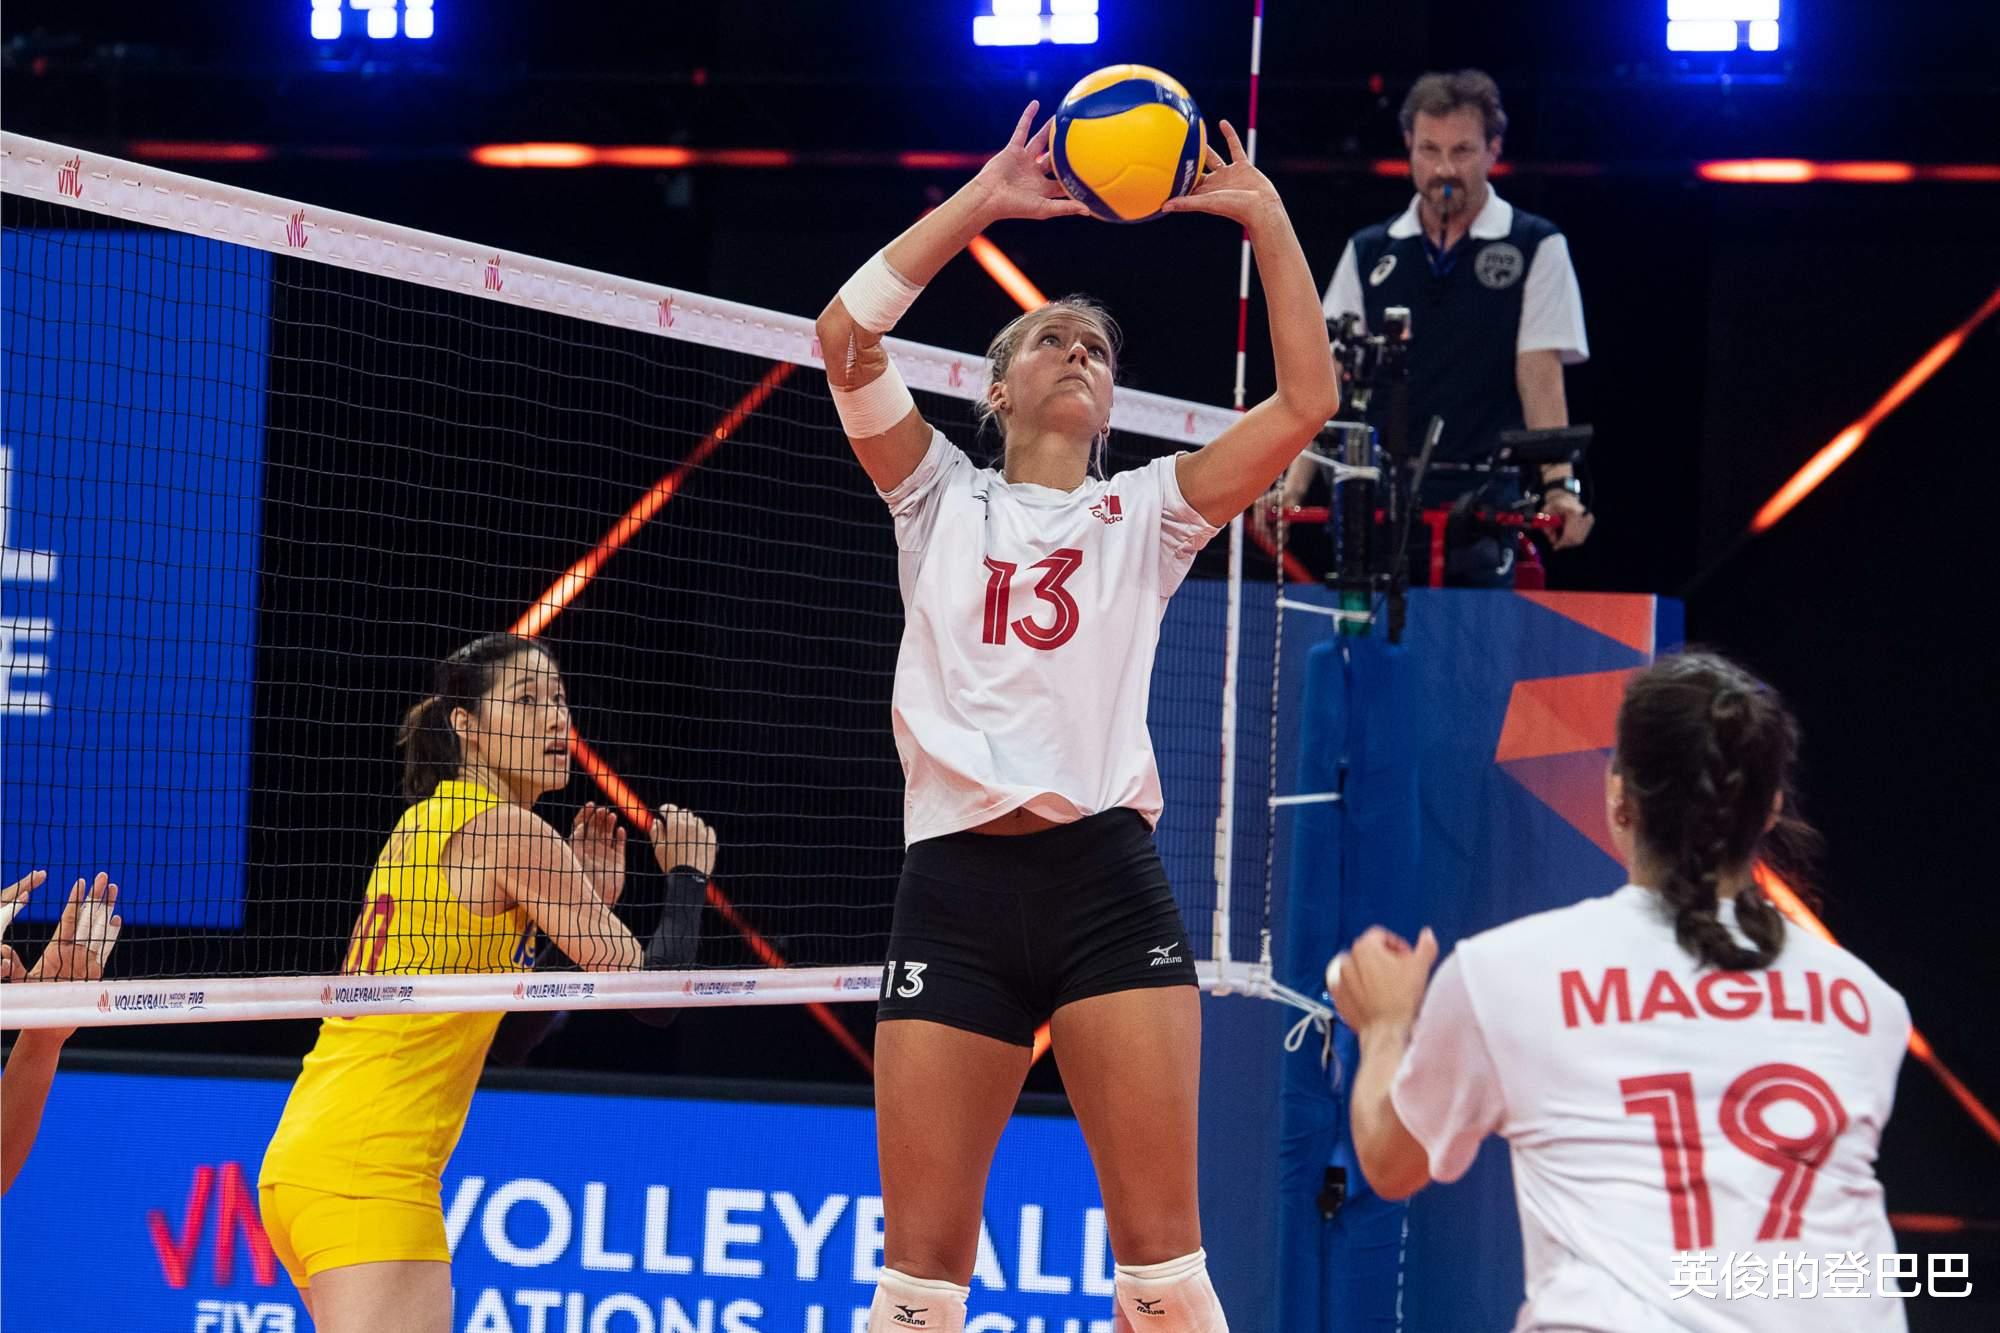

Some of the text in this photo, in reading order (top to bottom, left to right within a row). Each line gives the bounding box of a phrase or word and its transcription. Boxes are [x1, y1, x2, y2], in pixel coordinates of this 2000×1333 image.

[982, 547, 1084, 651] 13
[114, 993, 168, 1010] VOLLEYBALL
[335, 986, 381, 1003] VOLLEYBALL
[885, 960, 928, 998] 13
[1559, 967, 1871, 1036] MAGLIO
[1619, 1062, 1849, 1252] 19
